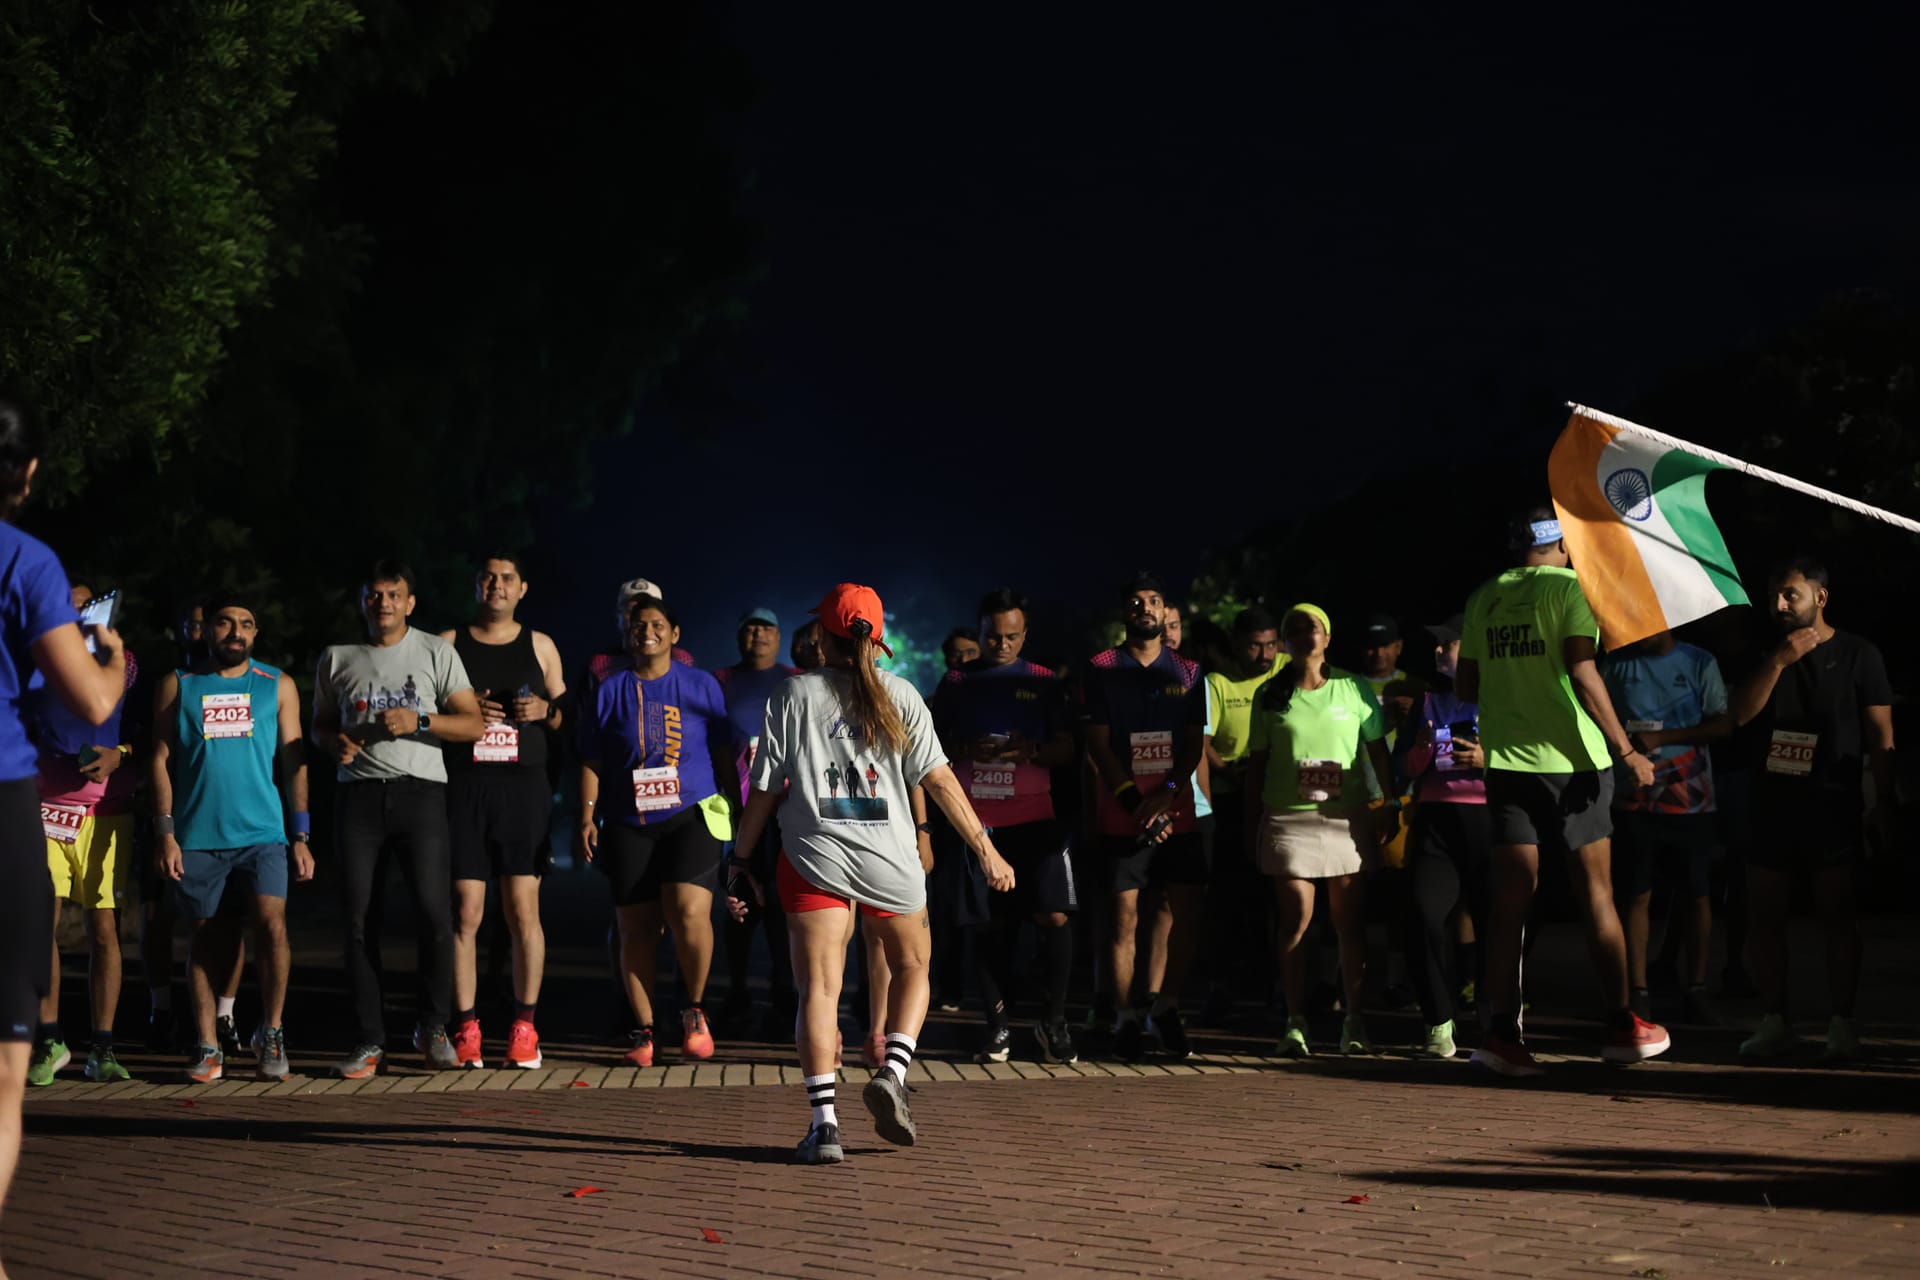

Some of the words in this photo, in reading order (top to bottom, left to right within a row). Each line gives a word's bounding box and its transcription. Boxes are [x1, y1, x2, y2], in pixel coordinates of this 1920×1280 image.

[204, 708, 249, 722] 2402
[1132, 745, 1171, 760] 2415
[1770, 744, 1813, 761] 2410
[973, 771, 1014, 785] 2408
[635, 781, 677, 797] 2413
[41, 808, 80, 828] 2411
